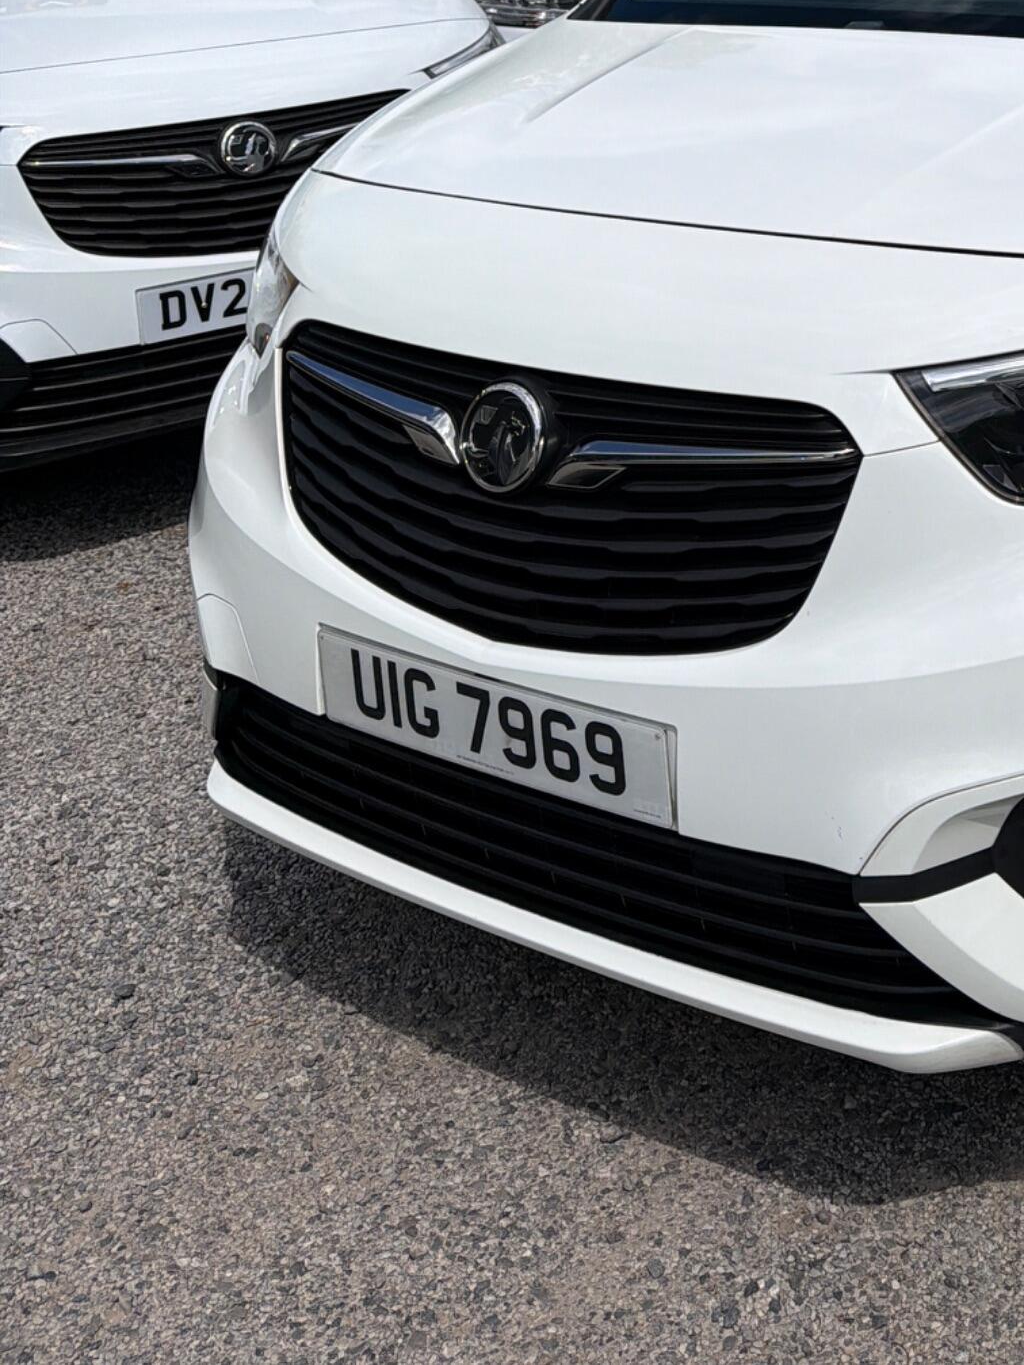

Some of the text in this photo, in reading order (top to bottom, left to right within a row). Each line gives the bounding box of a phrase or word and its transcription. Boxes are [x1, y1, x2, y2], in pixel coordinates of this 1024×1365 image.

[159, 278, 247, 331] DV2
[351, 648, 626, 796] UIG 7969
